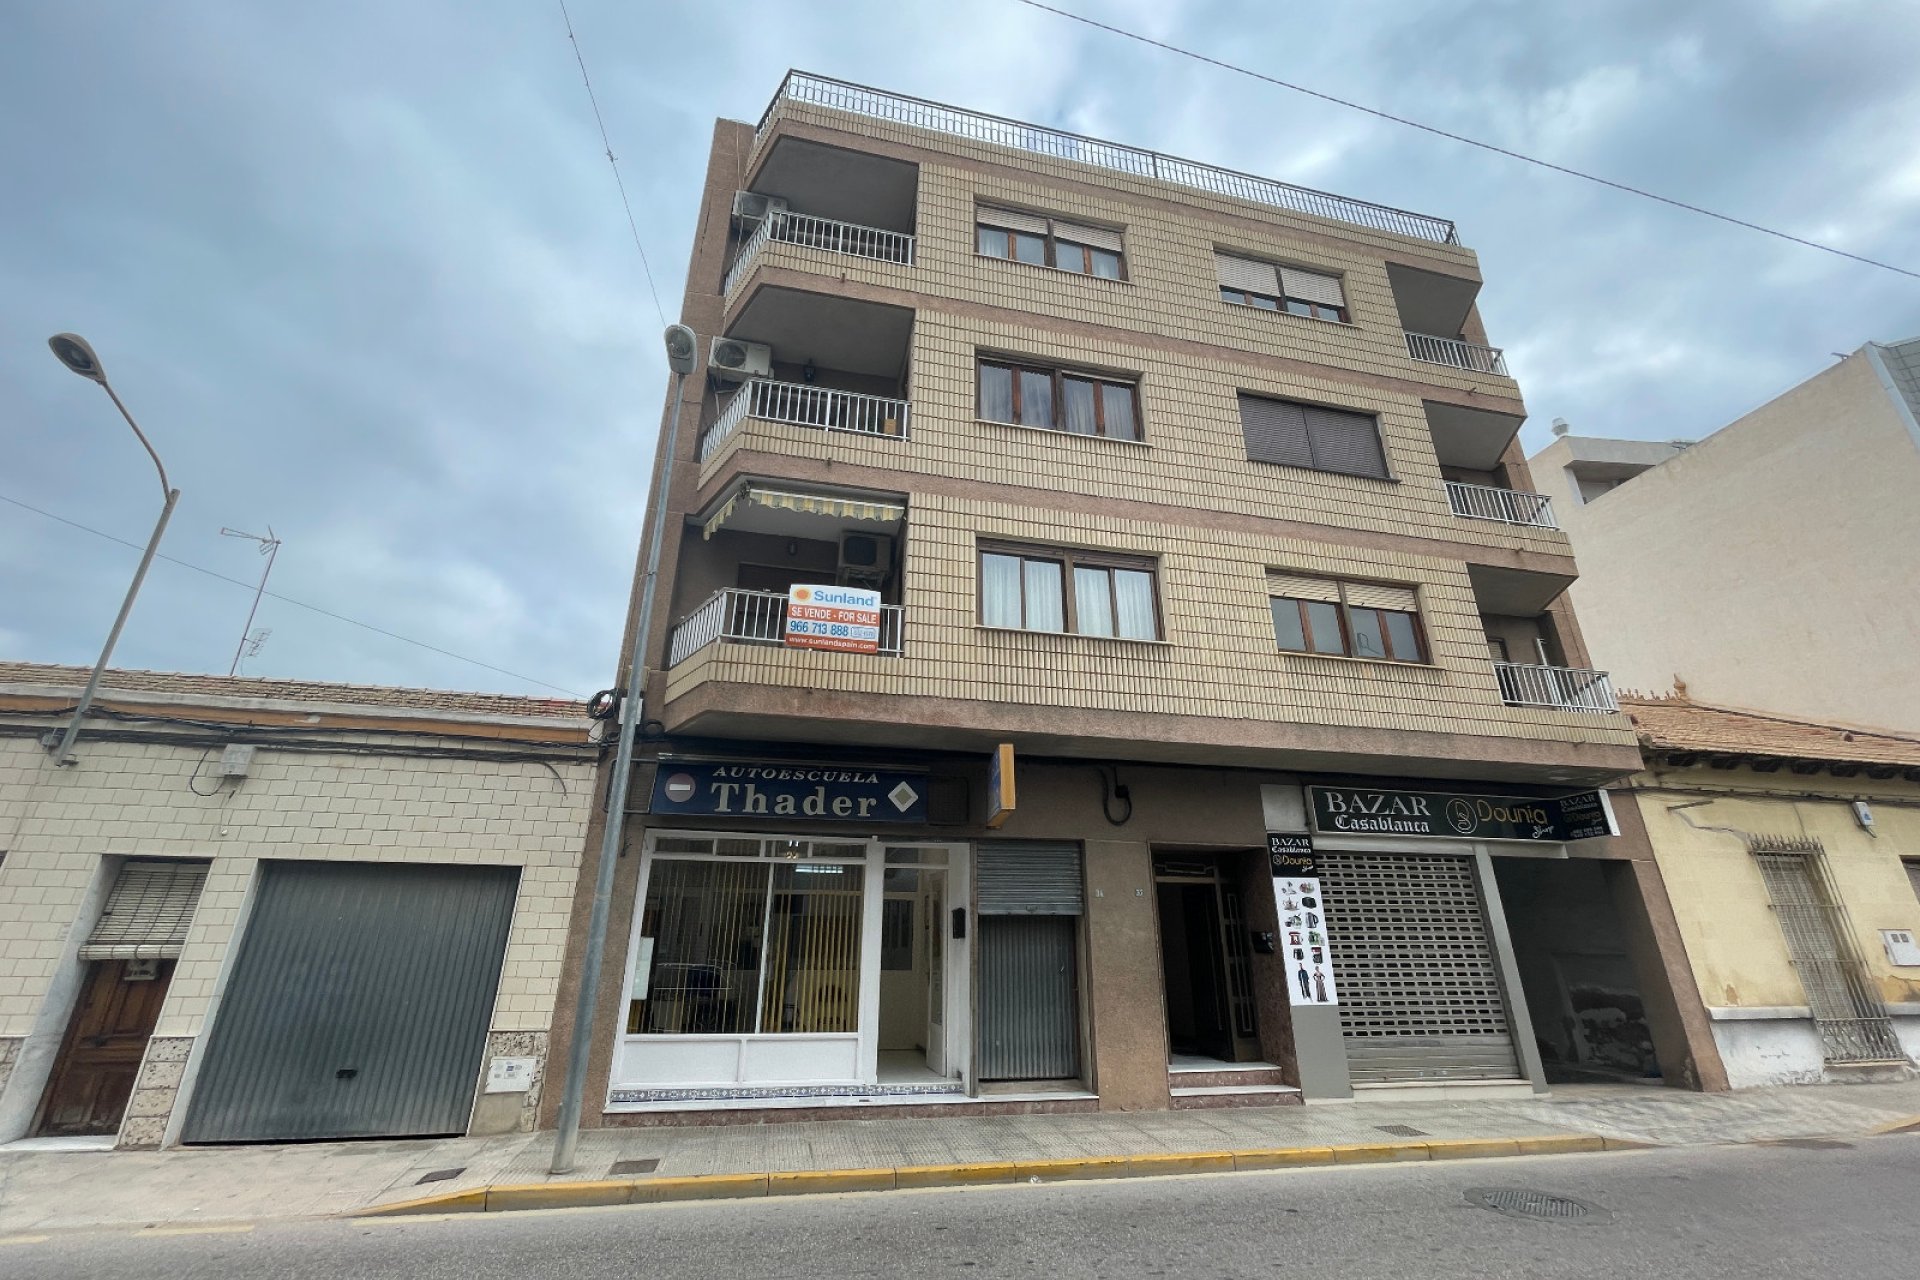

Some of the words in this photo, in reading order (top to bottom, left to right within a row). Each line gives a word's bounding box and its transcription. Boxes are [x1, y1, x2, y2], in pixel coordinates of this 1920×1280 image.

[814, 590, 875, 606] Sunland
[791, 606, 803, 617] SE
[804, 608, 831, 620] VENDE
[838, 611, 855, 622] FOR
[856, 613, 877, 624] SALE
[790, 620, 809, 633] 966
[811, 622, 828, 635] 713
[831, 624, 849, 636] 888
[789, 636, 876, 650] www.sunlandspain.com
[712, 766, 880, 784] AUTOESCUELA
[711, 782, 877, 817] Thader
[1324, 791, 1432, 816] BAZAR
[1476, 800, 1548, 825] Dounia
[1334, 814, 1430, 832] Casablanca
[1271, 837, 1309, 846] BAZAR
